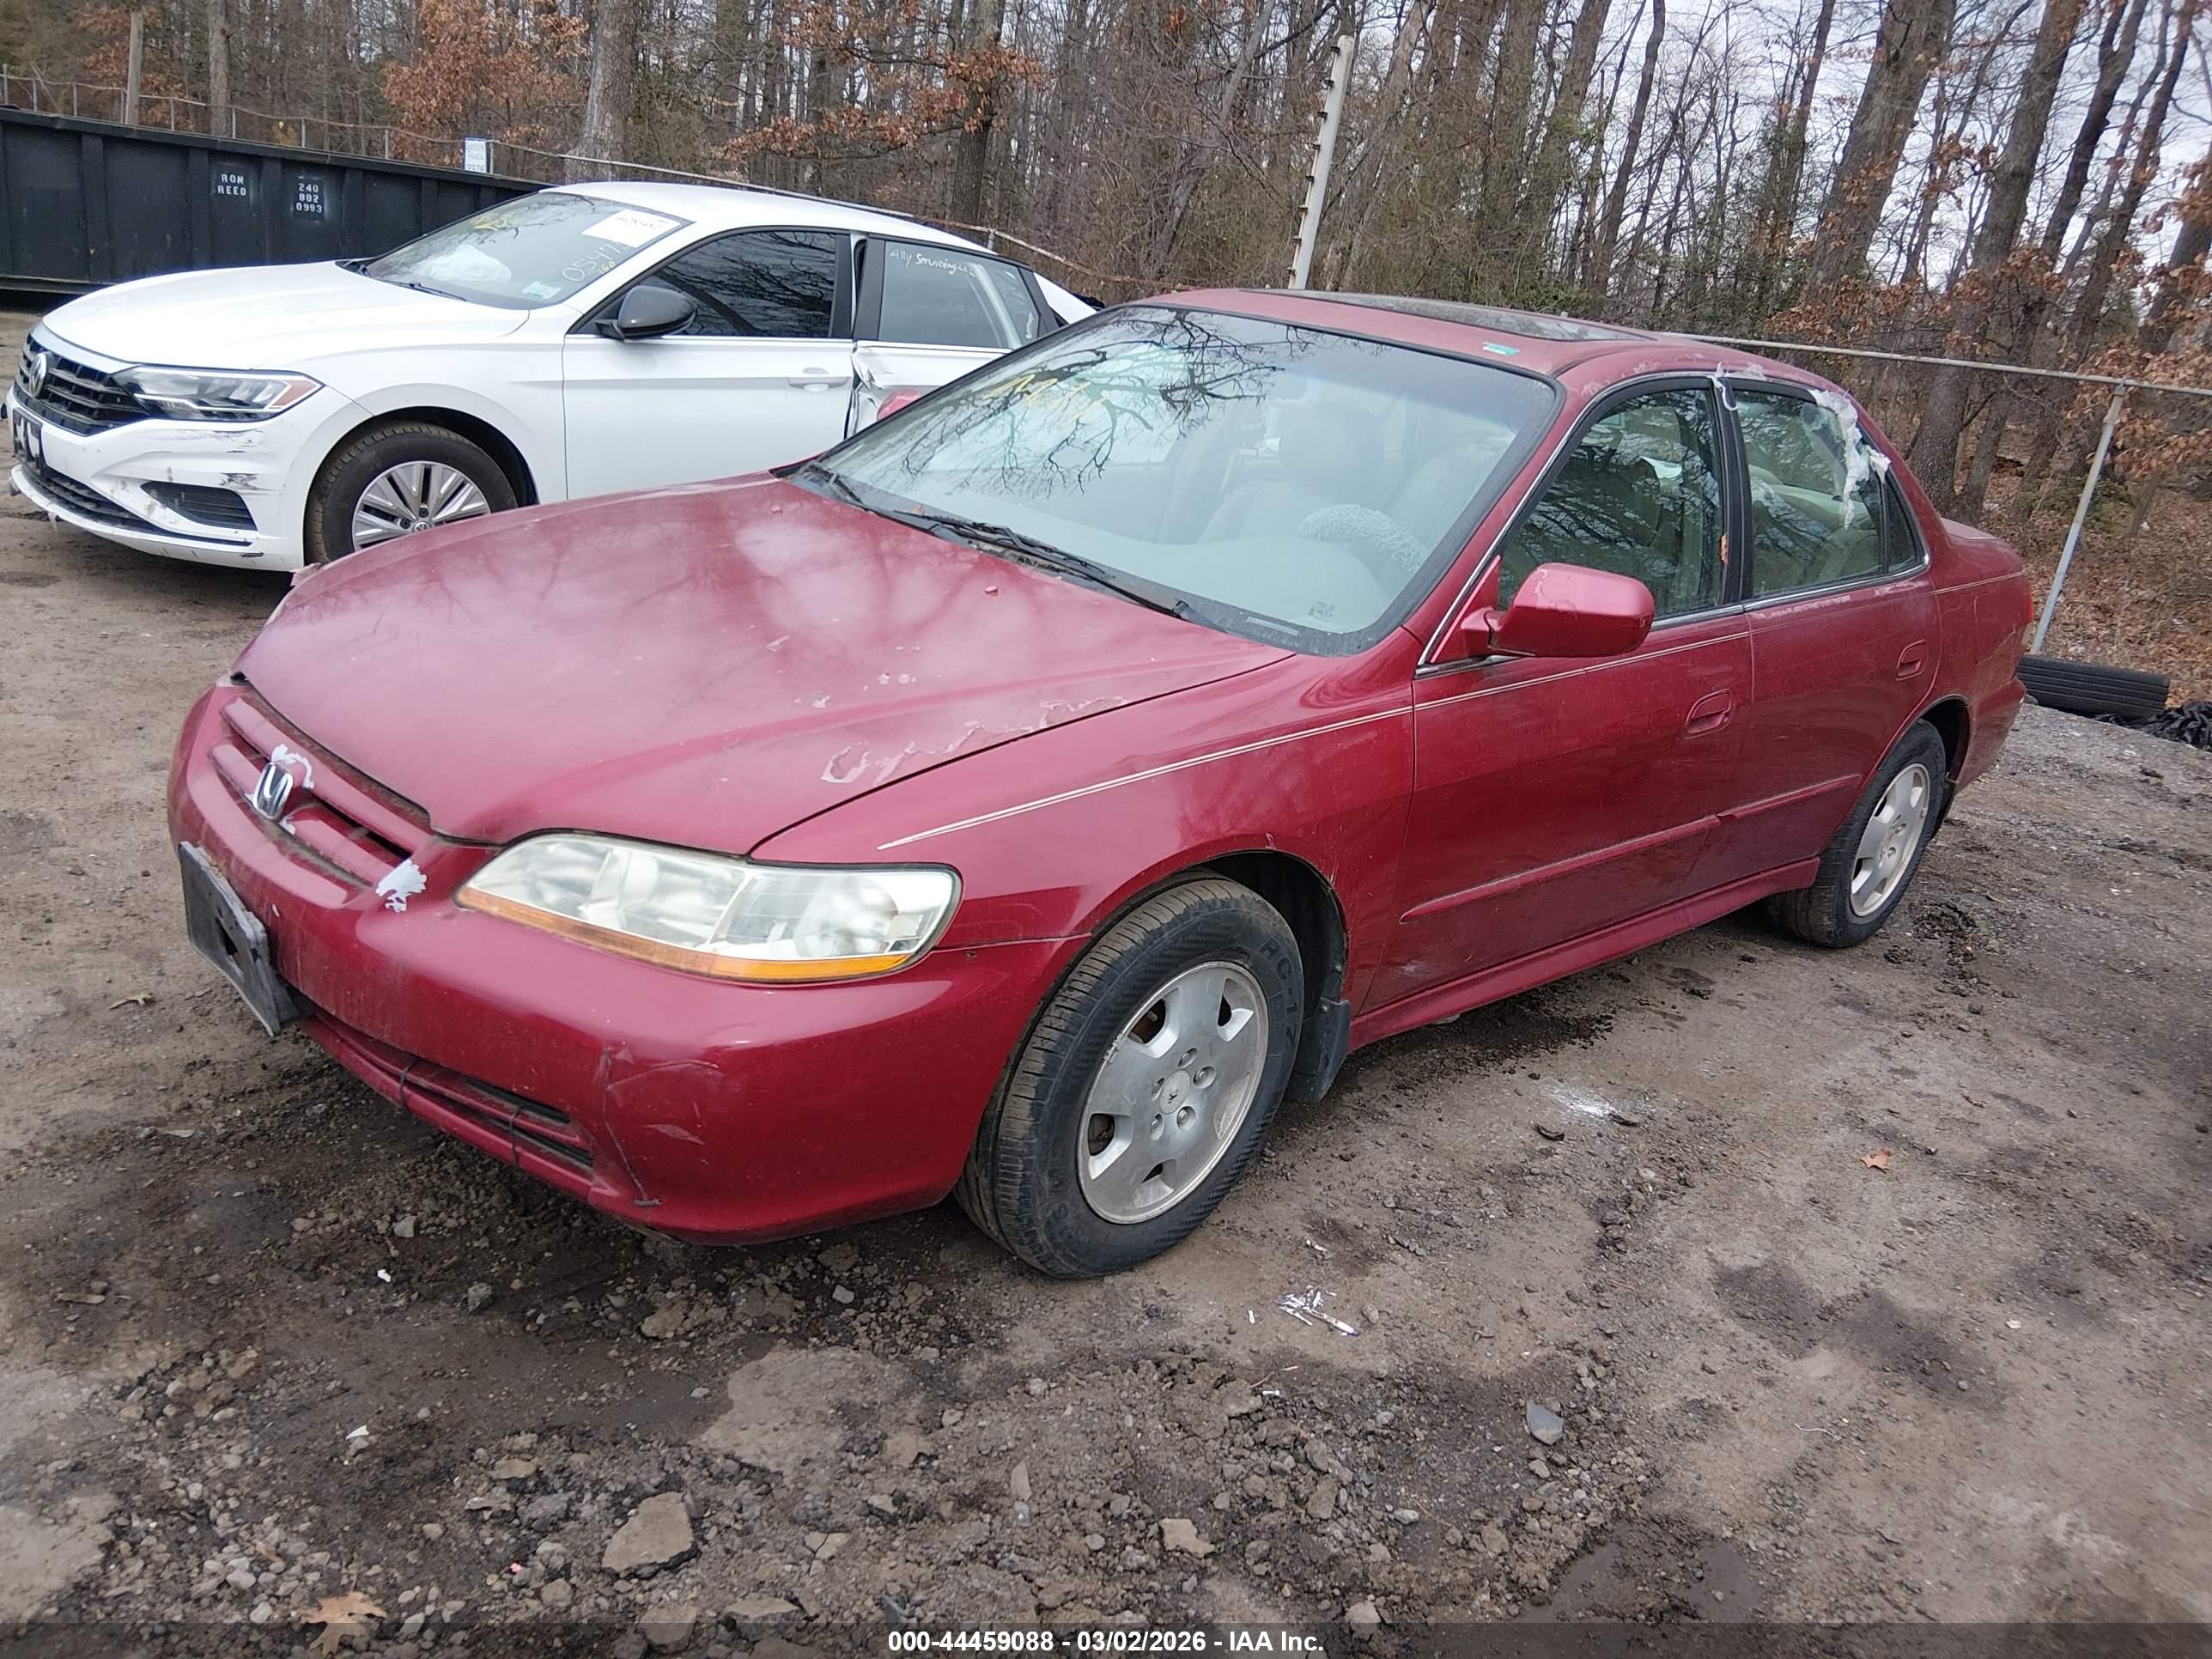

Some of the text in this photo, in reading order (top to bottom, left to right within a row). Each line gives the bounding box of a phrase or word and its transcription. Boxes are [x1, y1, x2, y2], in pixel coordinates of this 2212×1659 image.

[221, 173, 244, 185] RON
[217, 185, 246, 197] REED
[298, 183, 319, 193] 240
[295, 202, 322, 213] 0993
